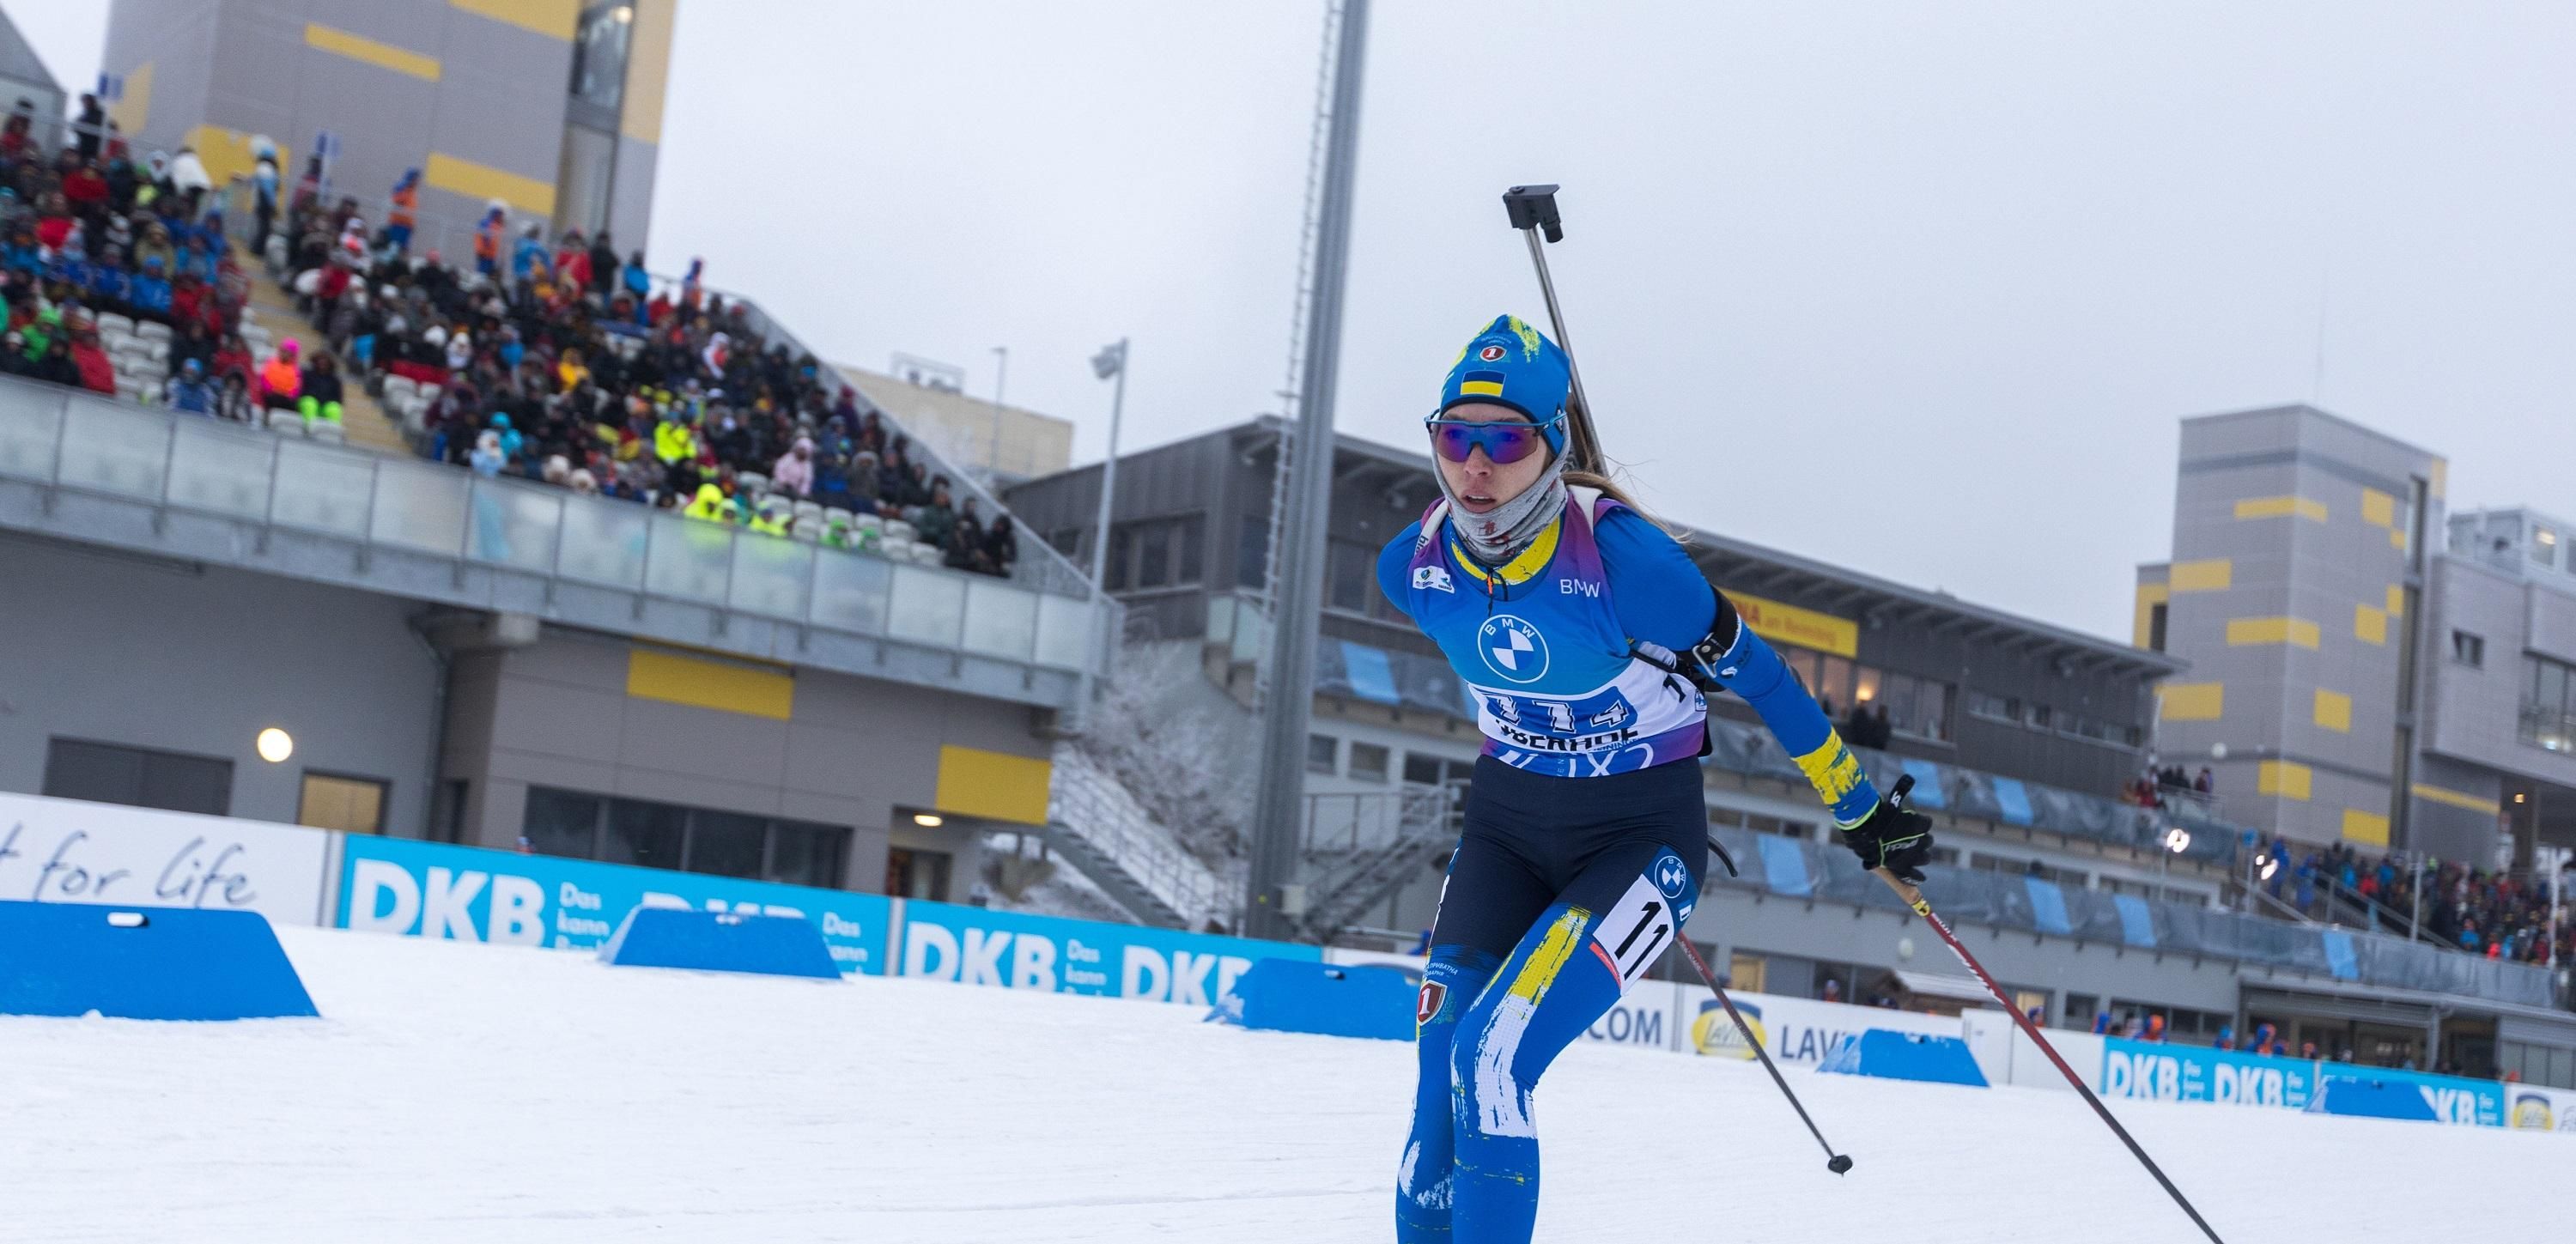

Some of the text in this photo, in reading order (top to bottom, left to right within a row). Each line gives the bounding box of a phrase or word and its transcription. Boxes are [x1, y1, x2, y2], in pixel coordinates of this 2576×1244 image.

[1560, 579, 1601, 598] BMW
[1485, 618, 1535, 640] BMW
[33, 830, 131, 901] for
[155, 836, 257, 908] life
[1668, 858, 1686, 882] BMW
[348, 857, 545, 948] DKB
[560, 881, 601, 911] Das
[556, 907, 611, 937] kann
[822, 911, 861, 938] Das
[828, 943, 870, 962] ann
[1066, 938, 1101, 963] Das
[1613, 901, 1669, 980] 11
[904, 920, 1057, 992] DKB
[1419, 987, 1431, 1016] 1
[1781, 1025, 1846, 1061] LAV
[2106, 1050, 2180, 1101] DKB
[2214, 1063, 2283, 1109] DKB
